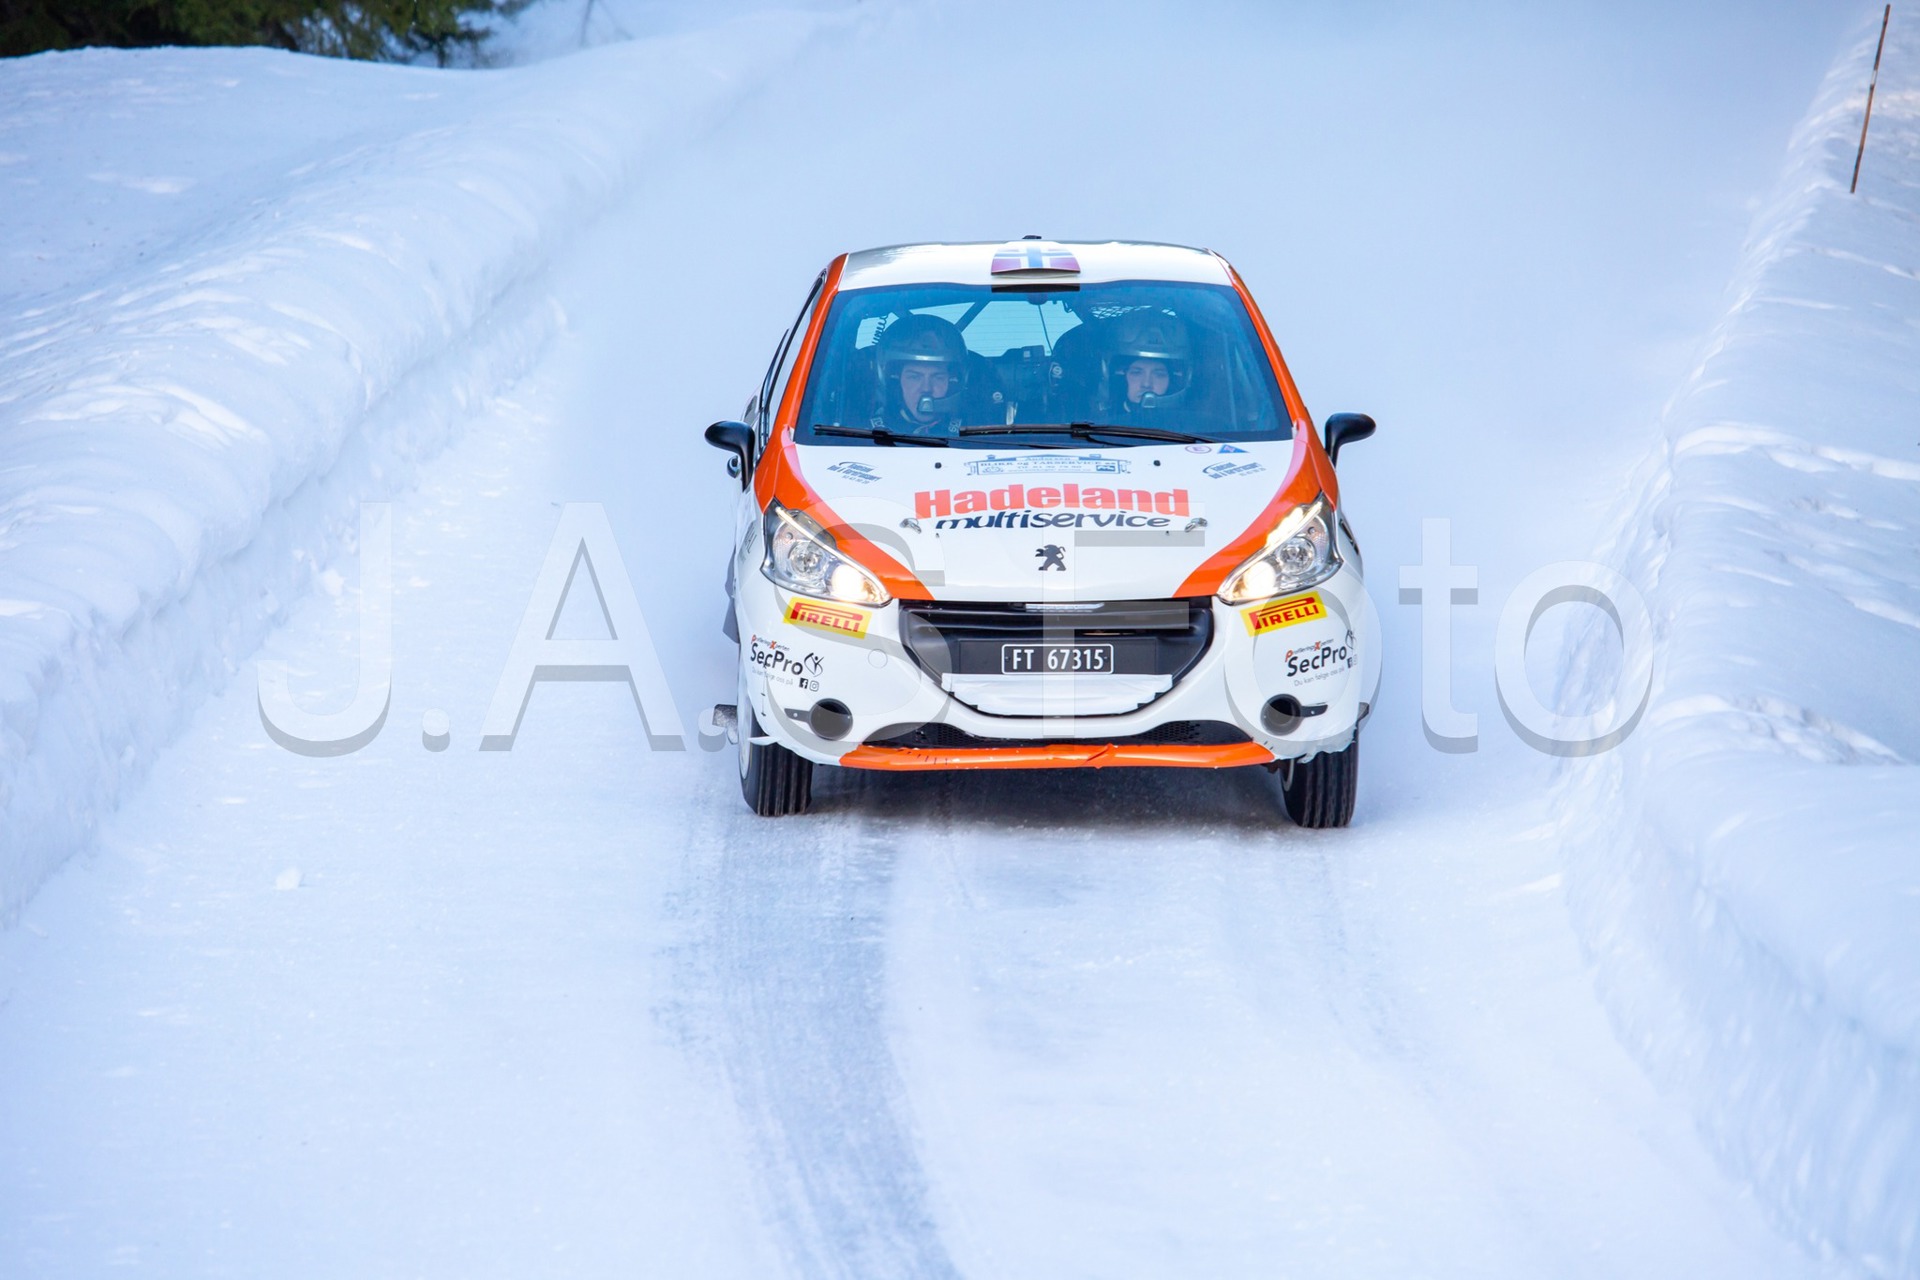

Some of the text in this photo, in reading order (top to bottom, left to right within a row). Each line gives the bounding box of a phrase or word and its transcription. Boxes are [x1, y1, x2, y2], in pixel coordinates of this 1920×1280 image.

[914, 483, 1190, 518] Hadeland
[935, 509, 1171, 530] multiservice
[789, 601, 864, 633] PIRELLI
[1248, 597, 1320, 630] PIRELLI
[750, 643, 804, 676] SecPro
[1012, 649, 1104, 670] FT 67315
[1286, 646, 1347, 678] SecPro
